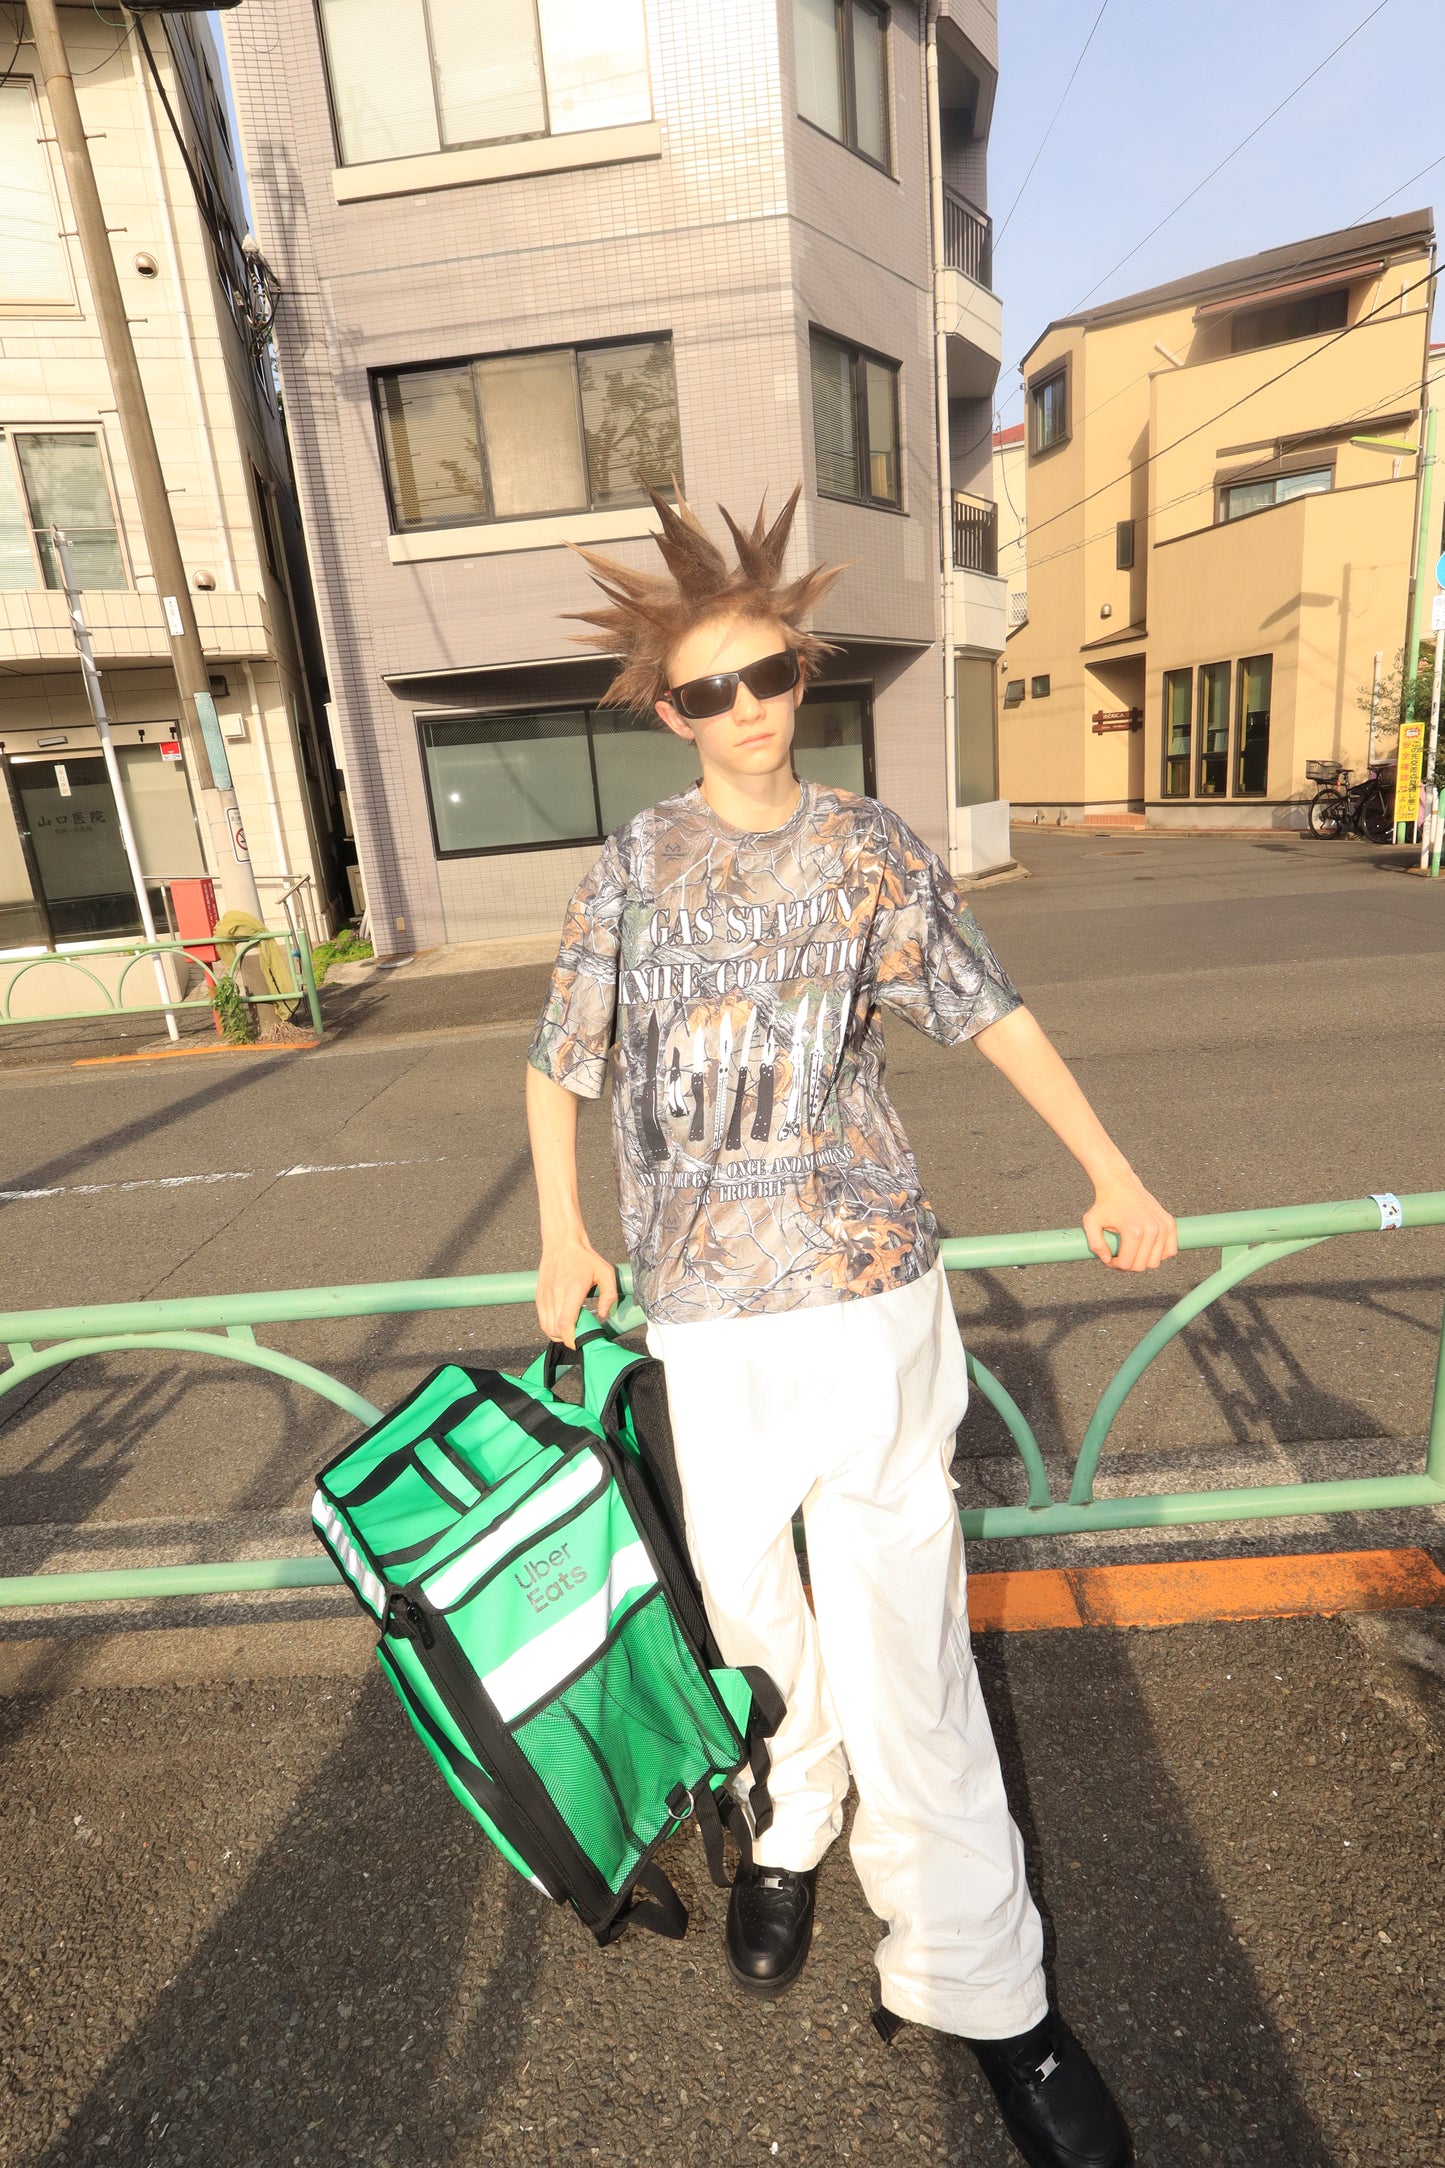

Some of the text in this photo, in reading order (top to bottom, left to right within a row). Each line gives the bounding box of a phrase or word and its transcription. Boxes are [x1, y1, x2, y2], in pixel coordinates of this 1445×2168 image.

[38, 810, 106, 827] 山口医院
[650, 887, 856, 946] GAS STATION
[727, 1159, 766, 1179] ONCE
[718, 1180, 786, 1203] TROUBLE
[514, 1542, 571, 1589] Uber
[527, 1566, 587, 1613] Eats
